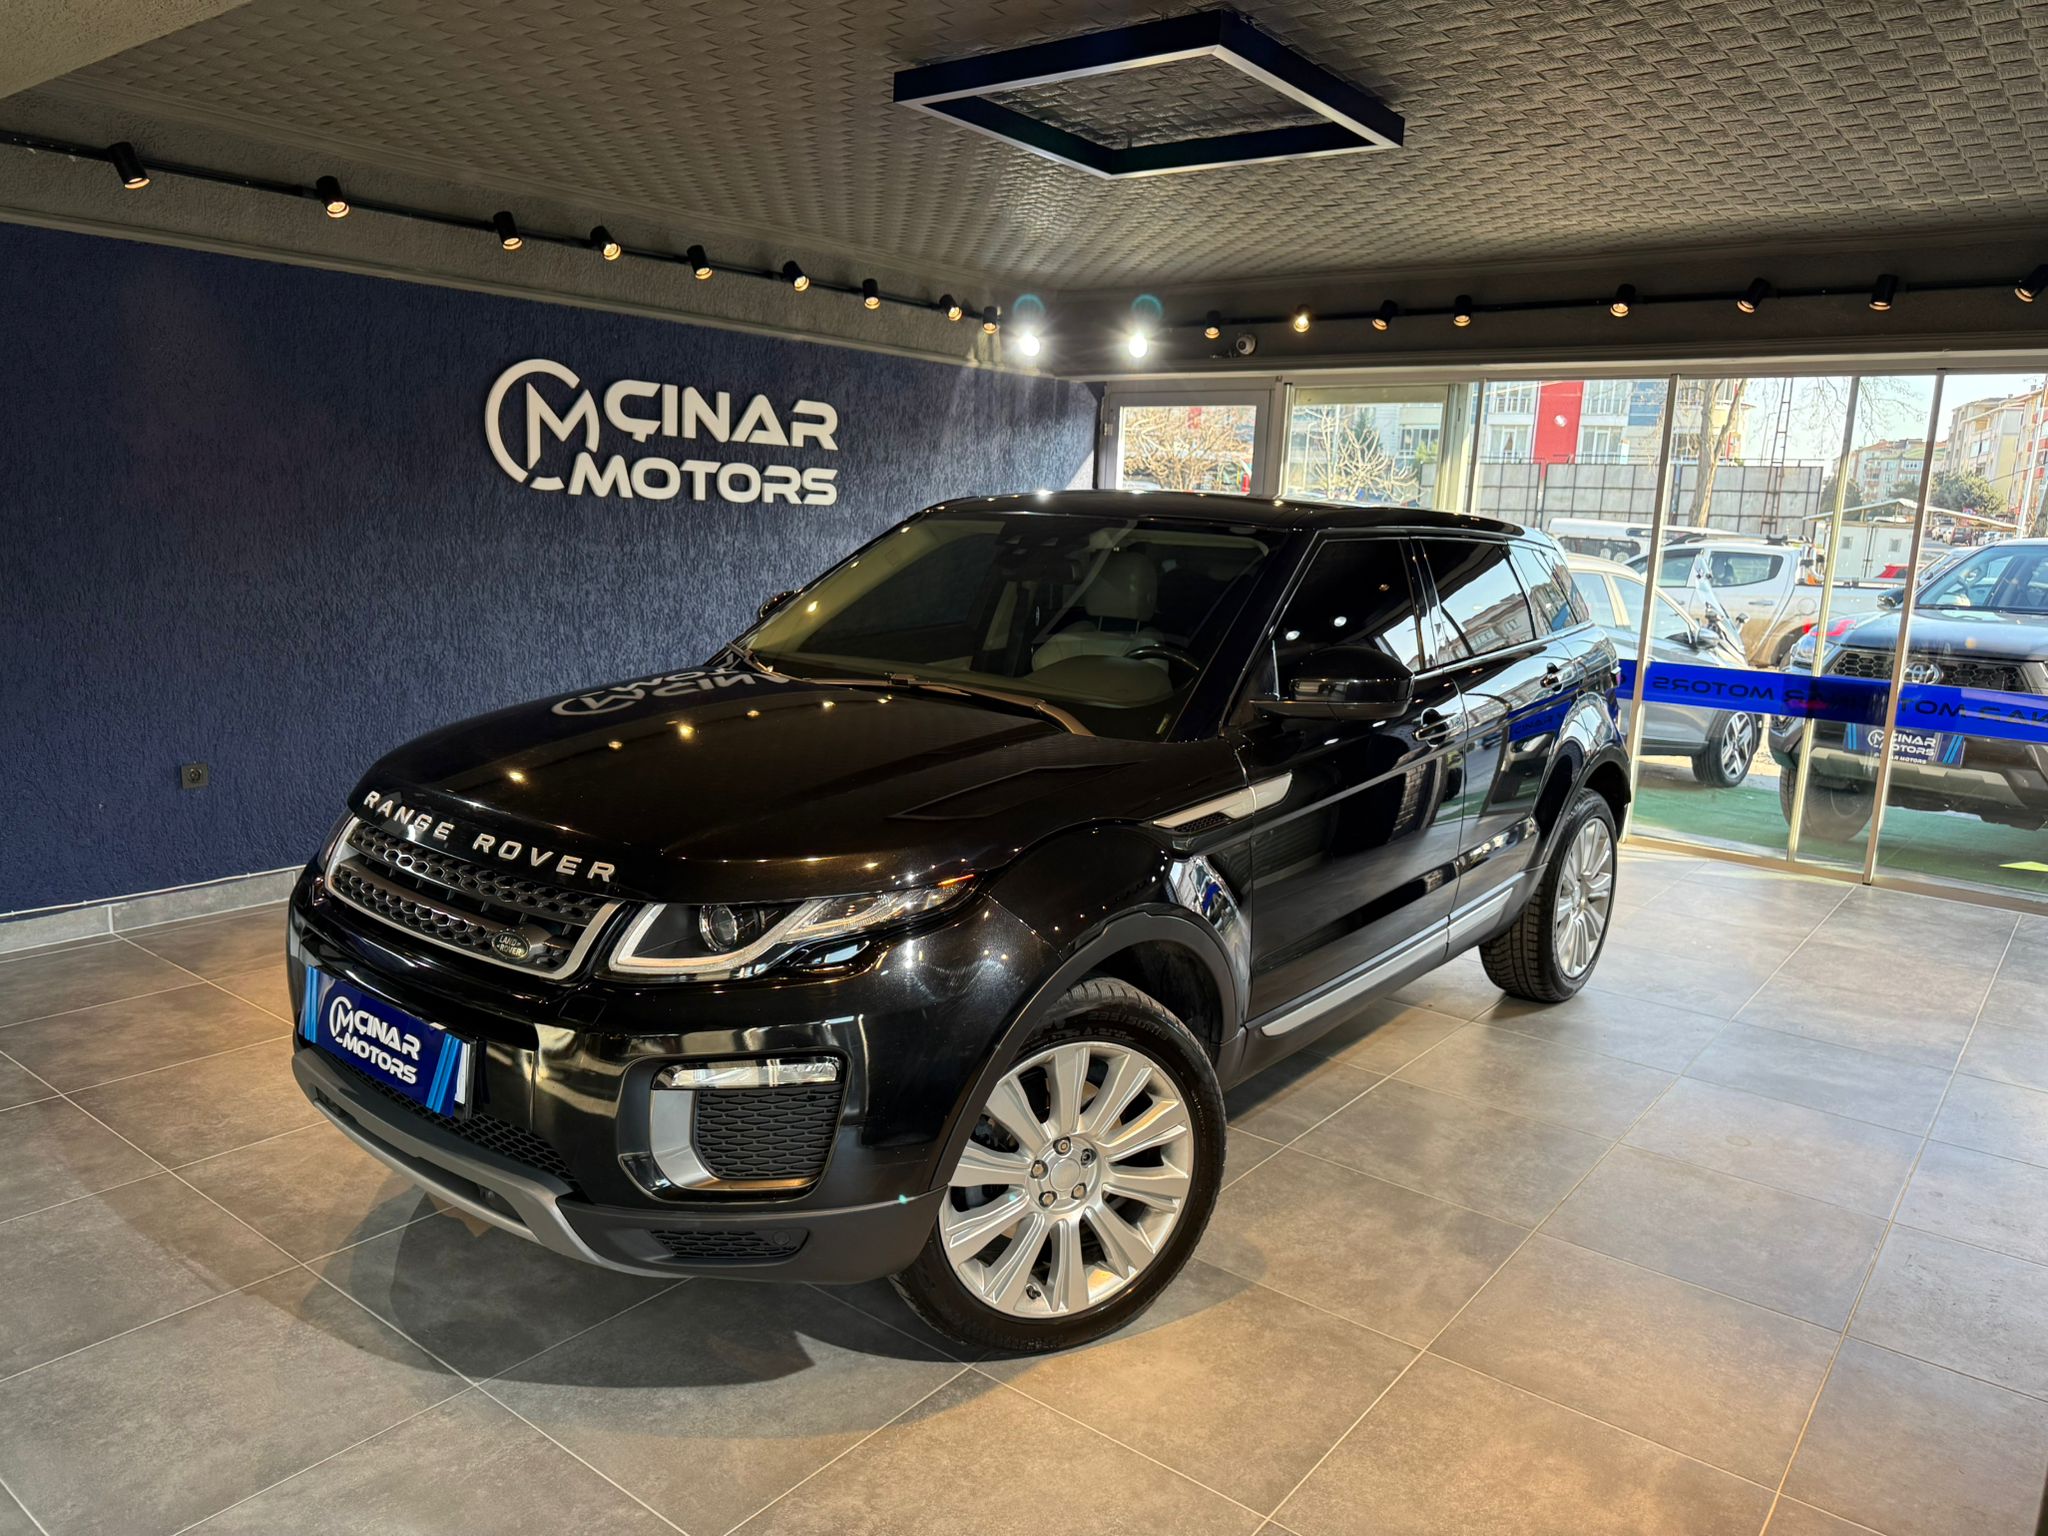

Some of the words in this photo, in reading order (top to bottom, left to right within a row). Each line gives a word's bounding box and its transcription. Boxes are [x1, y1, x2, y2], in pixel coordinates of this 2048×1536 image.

[603, 378, 839, 451] ÇINAR
[567, 451, 839, 506] MOTORS
[1879, 743, 1935, 757] OTORS
[363, 790, 455, 841] RANGE
[472, 832, 617, 883] ROVER
[498, 935, 518, 947] LAND
[498, 943, 522, 955] ROVER
[342, 1032, 419, 1085] MOTORS
[354, 1008, 422, 1062] ÇINAR
